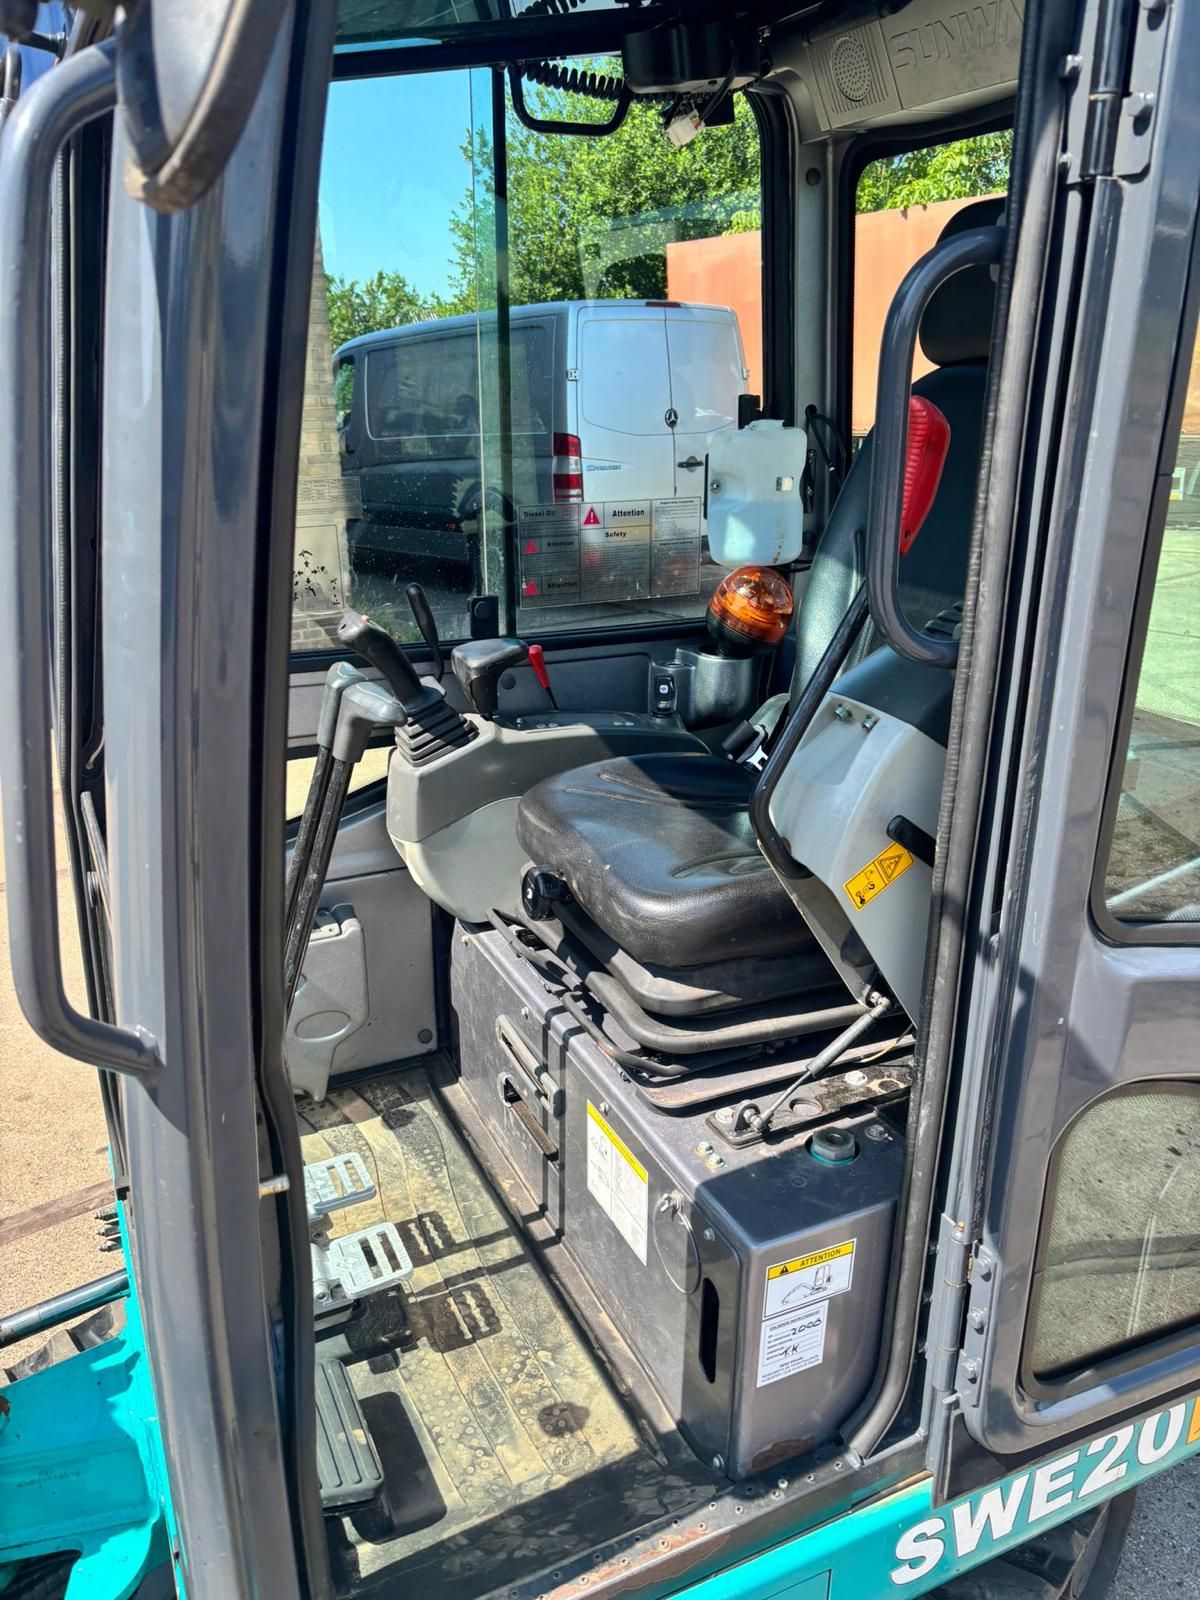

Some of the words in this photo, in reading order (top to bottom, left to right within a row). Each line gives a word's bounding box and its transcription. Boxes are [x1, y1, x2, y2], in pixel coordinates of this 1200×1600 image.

[612, 508, 645, 518] Attention
[605, 531, 627, 539] Safety
[547, 581, 578, 589] Attention
[799, 1248, 842, 1267] ATTENTION
[890, 1402, 1187, 1585] SWE20
